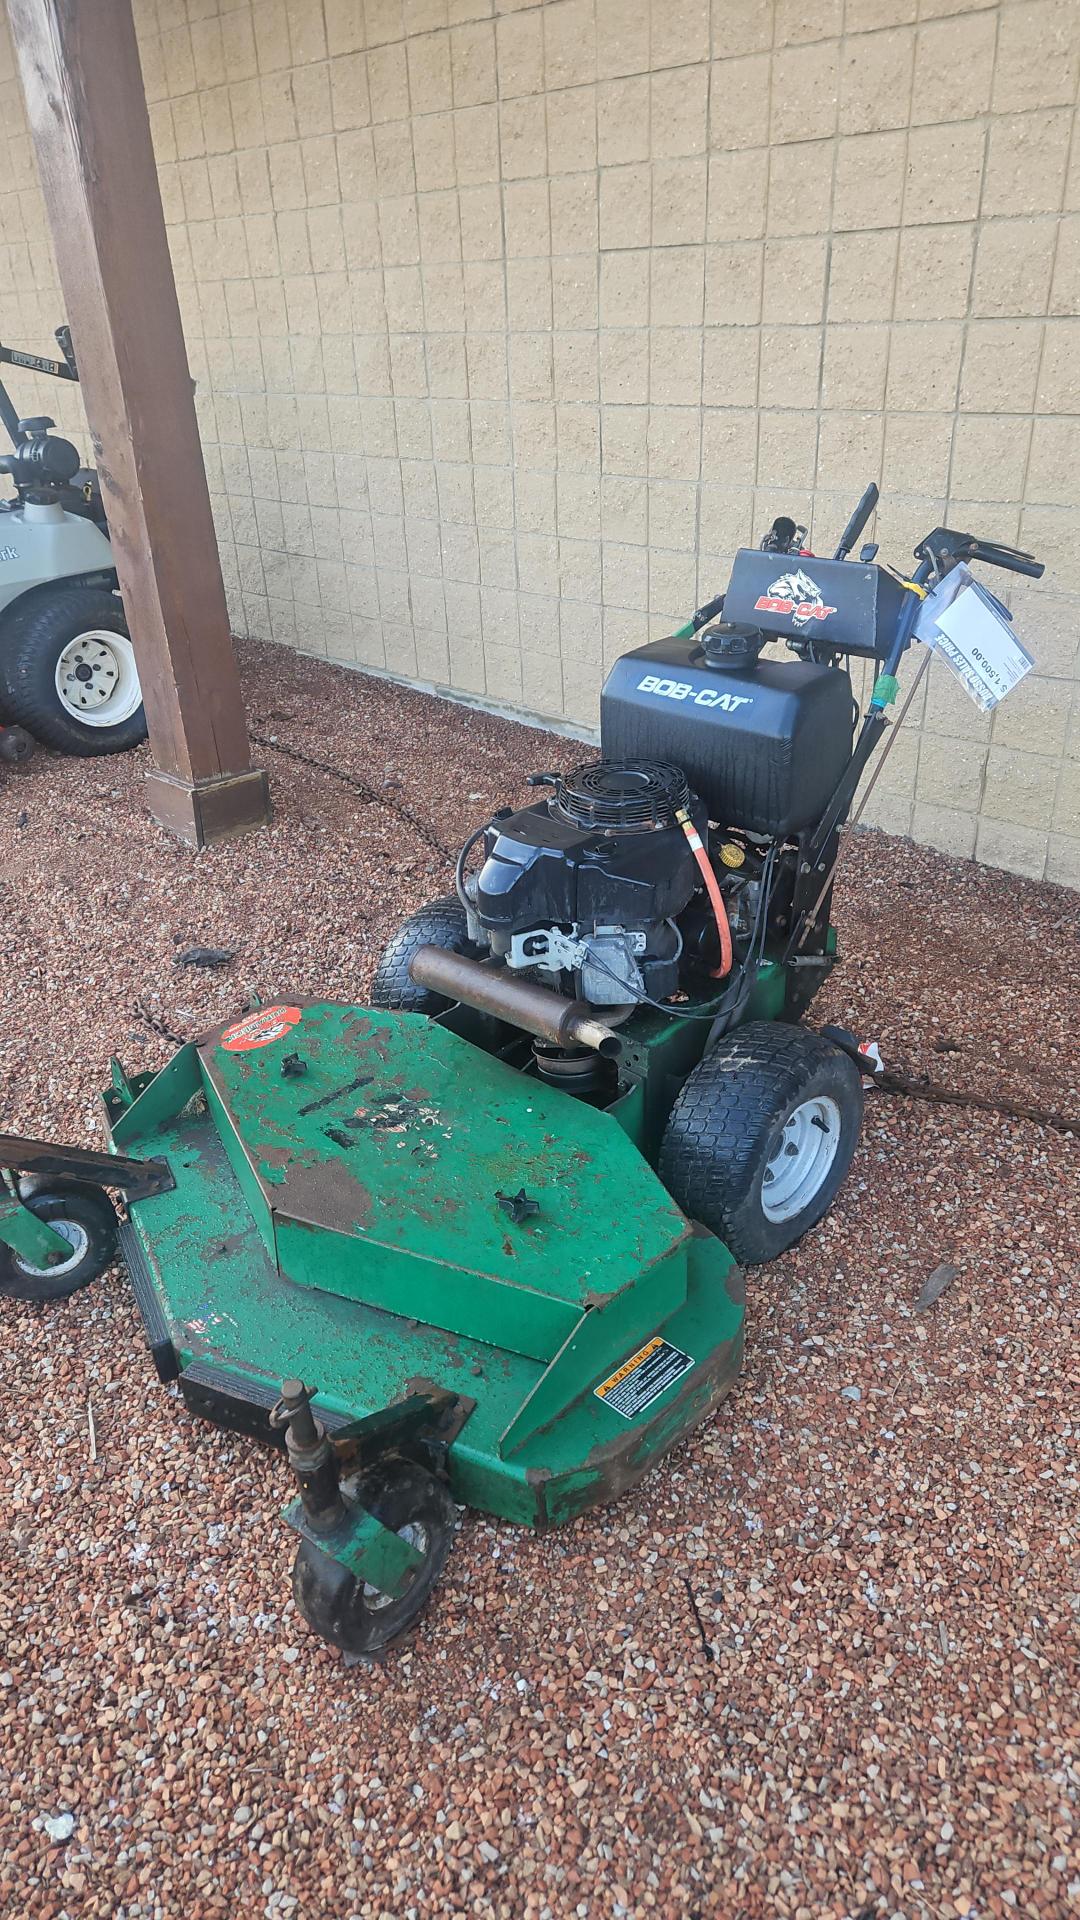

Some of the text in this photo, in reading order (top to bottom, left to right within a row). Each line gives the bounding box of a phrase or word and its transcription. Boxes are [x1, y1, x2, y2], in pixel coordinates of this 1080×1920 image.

[0, 545, 19, 561] rk
[754, 596, 834, 620] BOB-CAT
[935, 633, 959, 658] PRICE
[953, 655, 977, 680] SALES
[971, 647, 1001, 685] 1,500.00
[637, 675, 752, 712] BOB-CAT
[611, 1350, 649, 1383] WARNING
